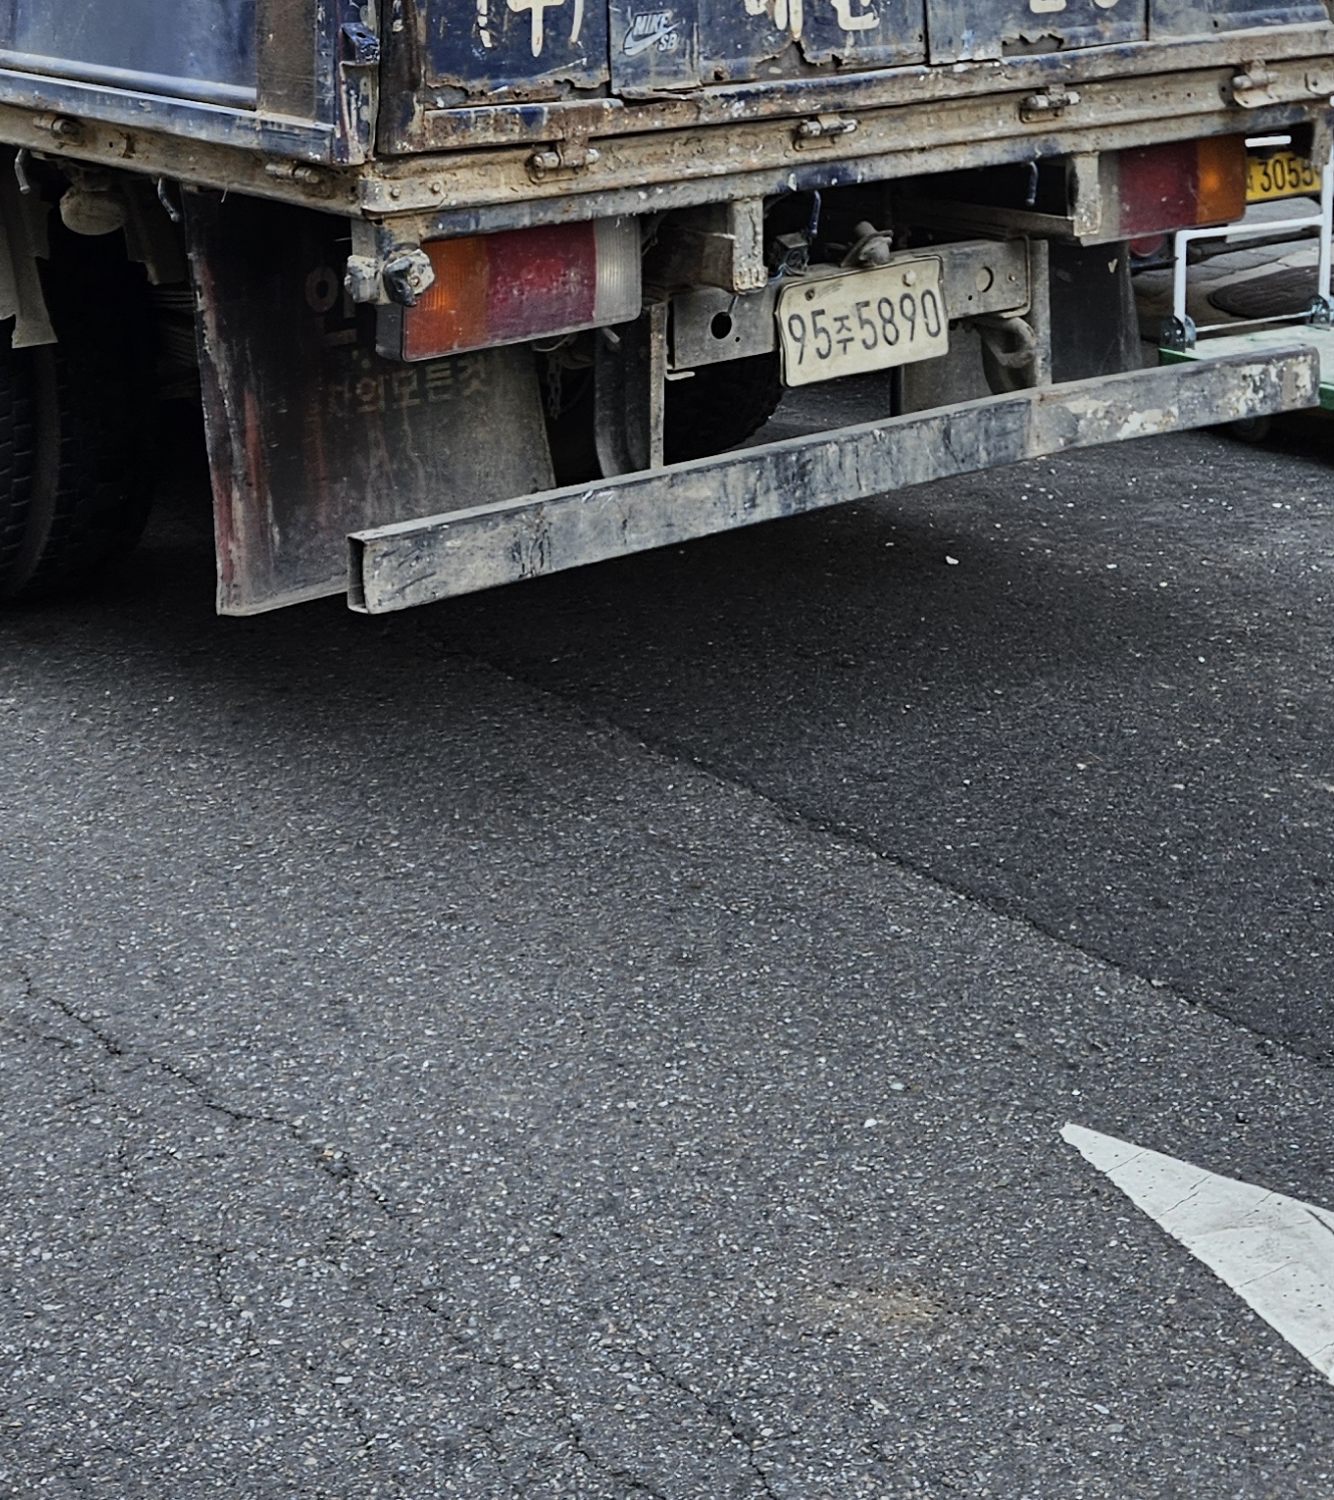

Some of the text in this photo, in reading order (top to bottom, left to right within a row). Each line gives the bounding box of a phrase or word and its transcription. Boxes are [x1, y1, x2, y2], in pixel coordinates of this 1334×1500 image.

[633, 12, 670, 36] NIKE
[658, 33, 678, 51] SB
[788, 288, 941, 365] 95주5890
